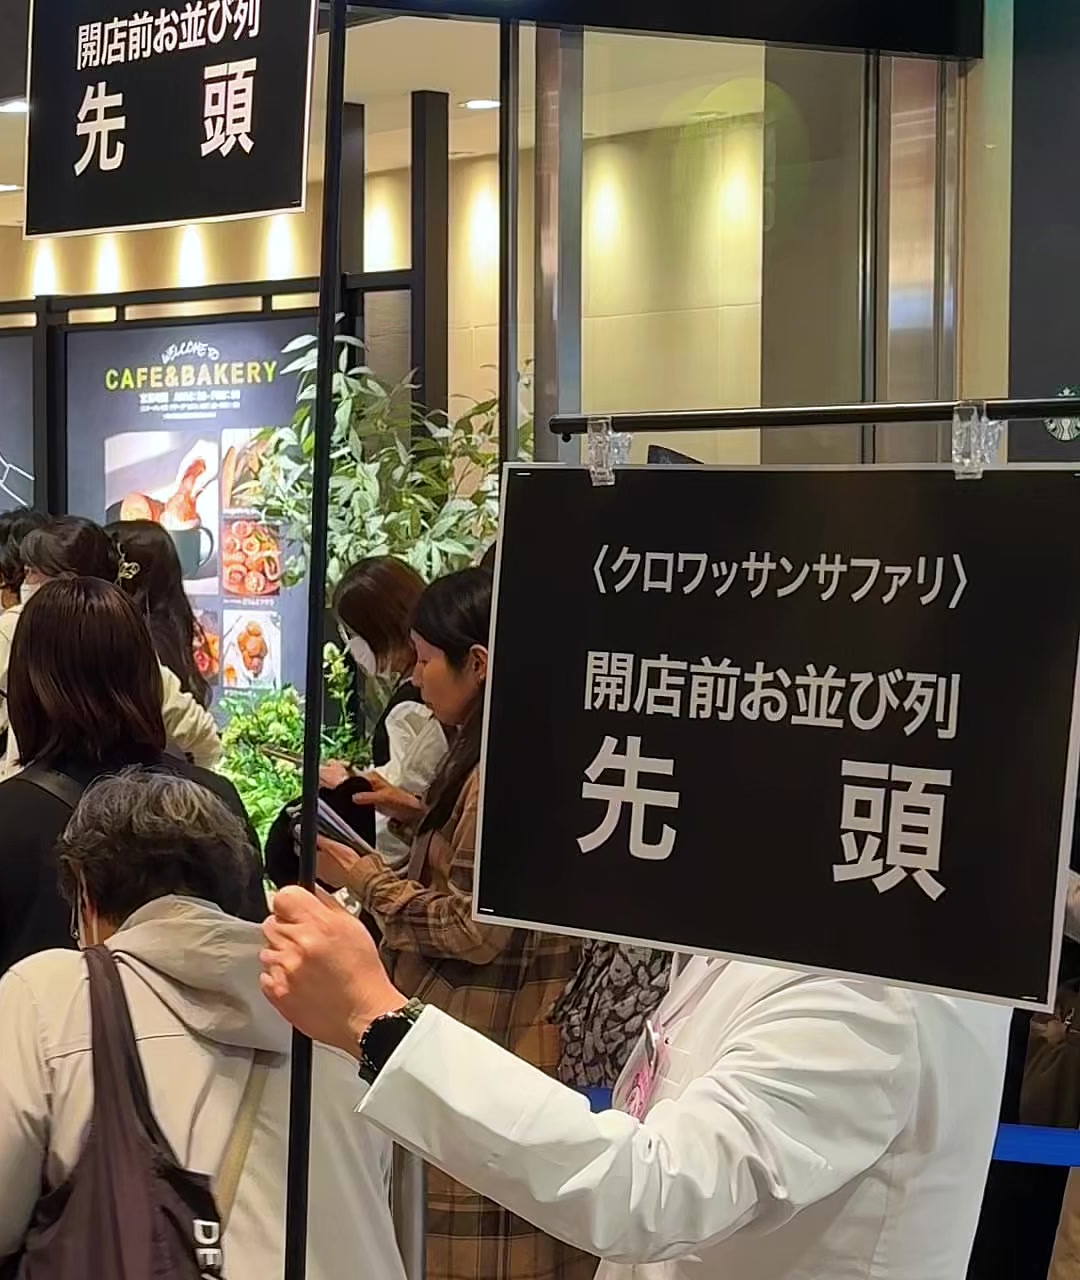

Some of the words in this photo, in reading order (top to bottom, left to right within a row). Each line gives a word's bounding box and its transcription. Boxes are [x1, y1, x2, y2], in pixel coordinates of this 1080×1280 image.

[105, 361, 277, 390] CAFE&BAKERY
[583, 650, 961, 739] 開店前お並び列
